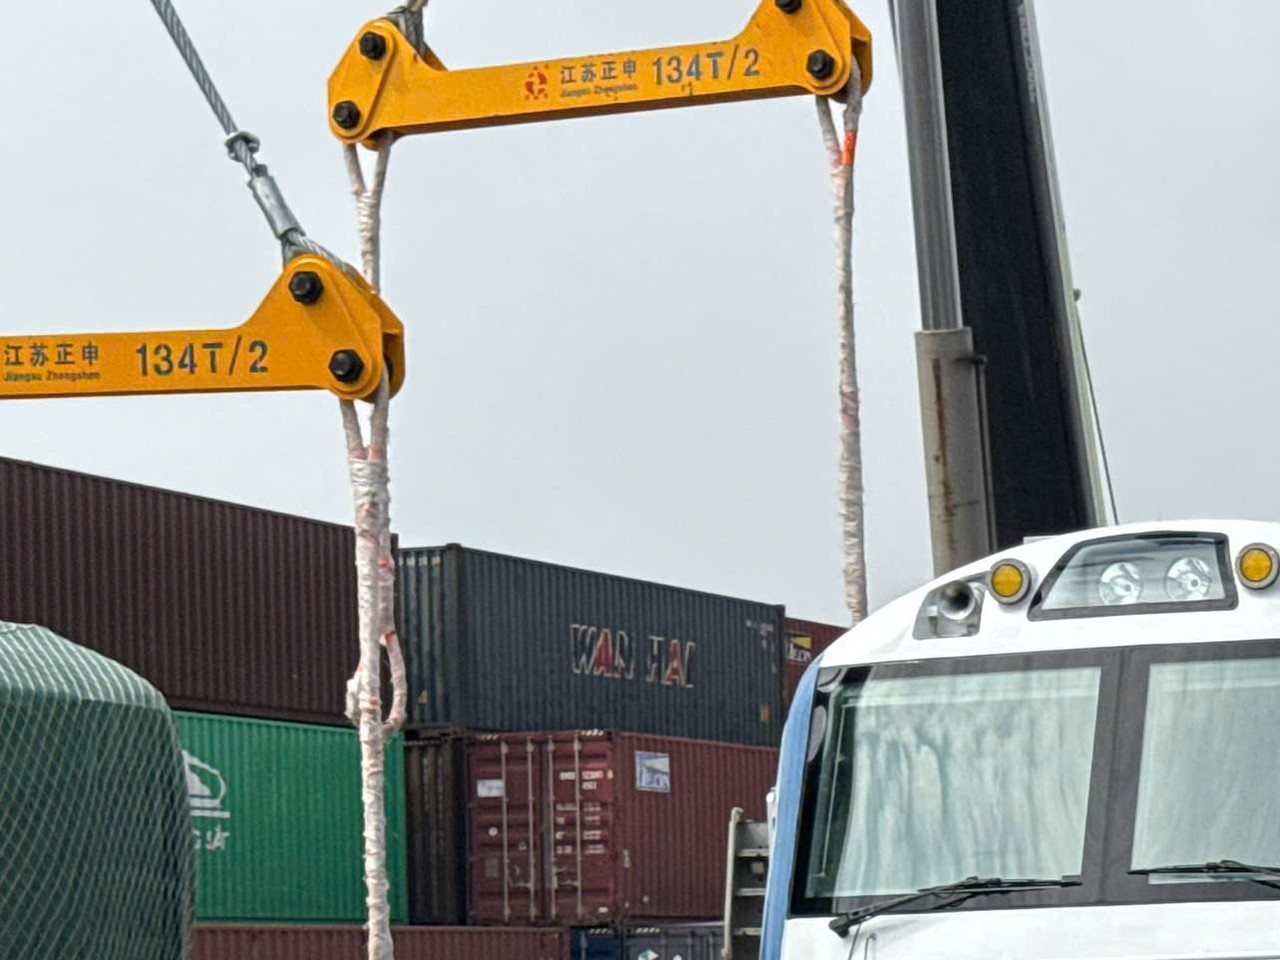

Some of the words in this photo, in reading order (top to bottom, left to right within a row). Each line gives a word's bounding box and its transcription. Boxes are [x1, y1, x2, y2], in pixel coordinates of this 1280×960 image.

[559, 58, 638, 85] 江苏正申
[652, 44, 761, 86] 134T/2
[4, 341, 99, 367] 江苏正申
[135, 334, 270, 377] 134T/2
[570, 624, 635, 680] WAN
